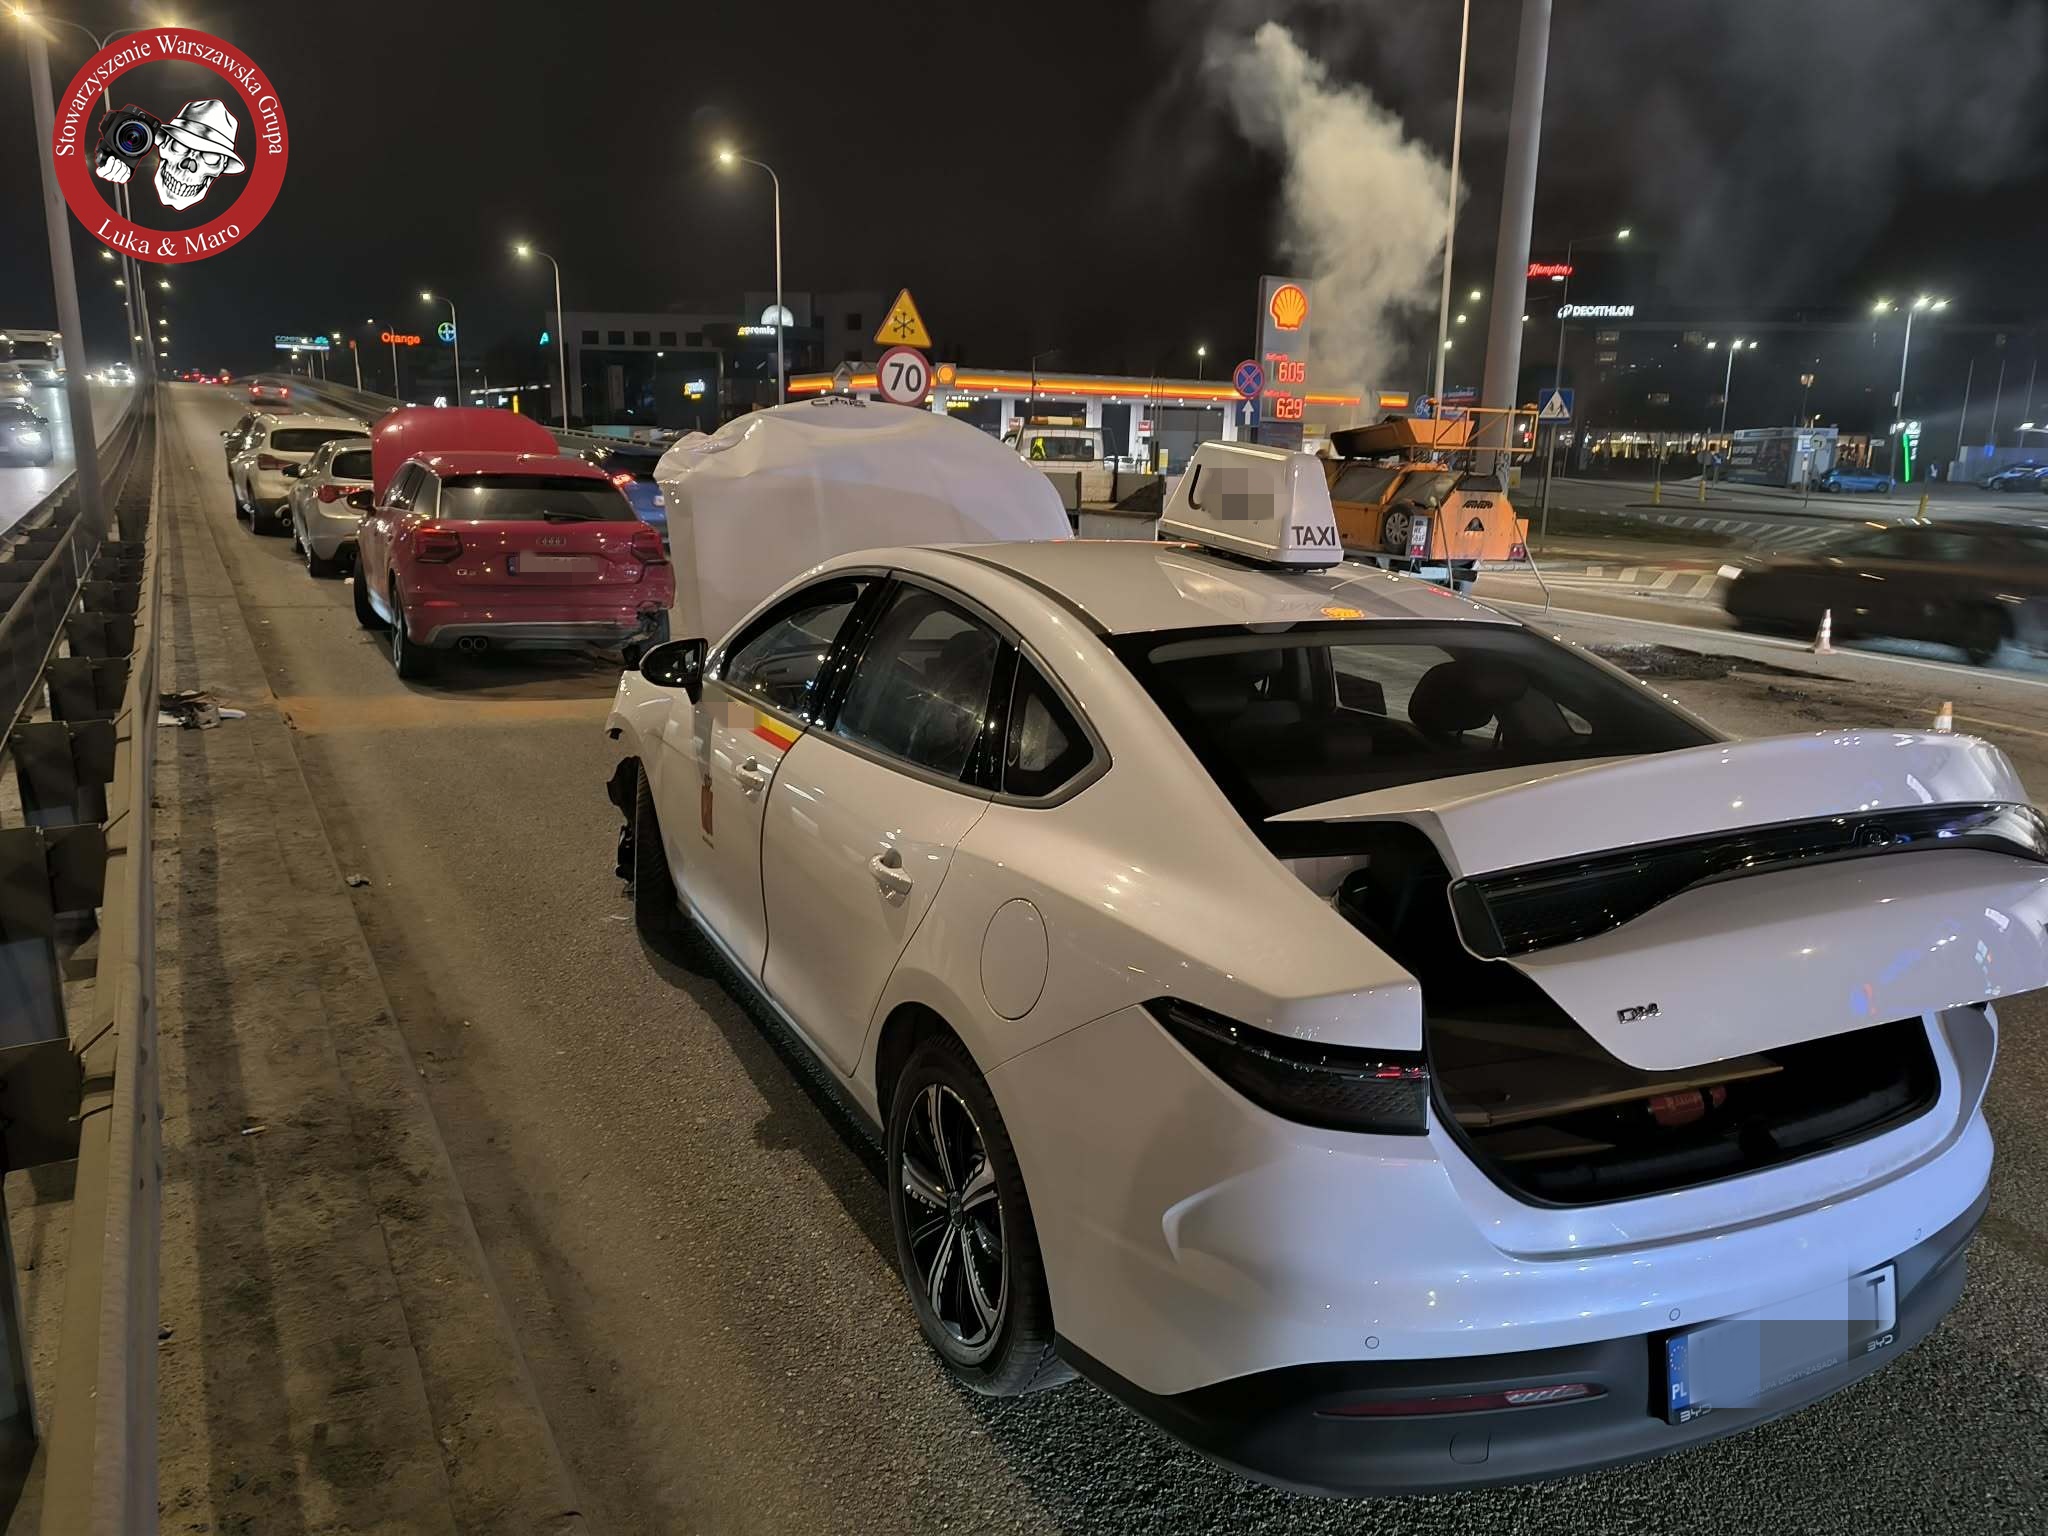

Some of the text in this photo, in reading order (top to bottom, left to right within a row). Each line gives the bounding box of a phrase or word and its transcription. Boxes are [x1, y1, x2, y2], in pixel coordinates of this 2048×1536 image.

[1527, 264, 1573, 276] Hampton
[1572, 305, 1635, 317] DECATHLON
[381, 332, 421, 346] Orange
[889, 362, 922, 393] 70
[1291, 525, 1336, 546] TAXI
[1867, 1333, 1894, 1352] BYD
[1671, 1383, 1688, 1401] PL
[1679, 1403, 1712, 1423] BYD
